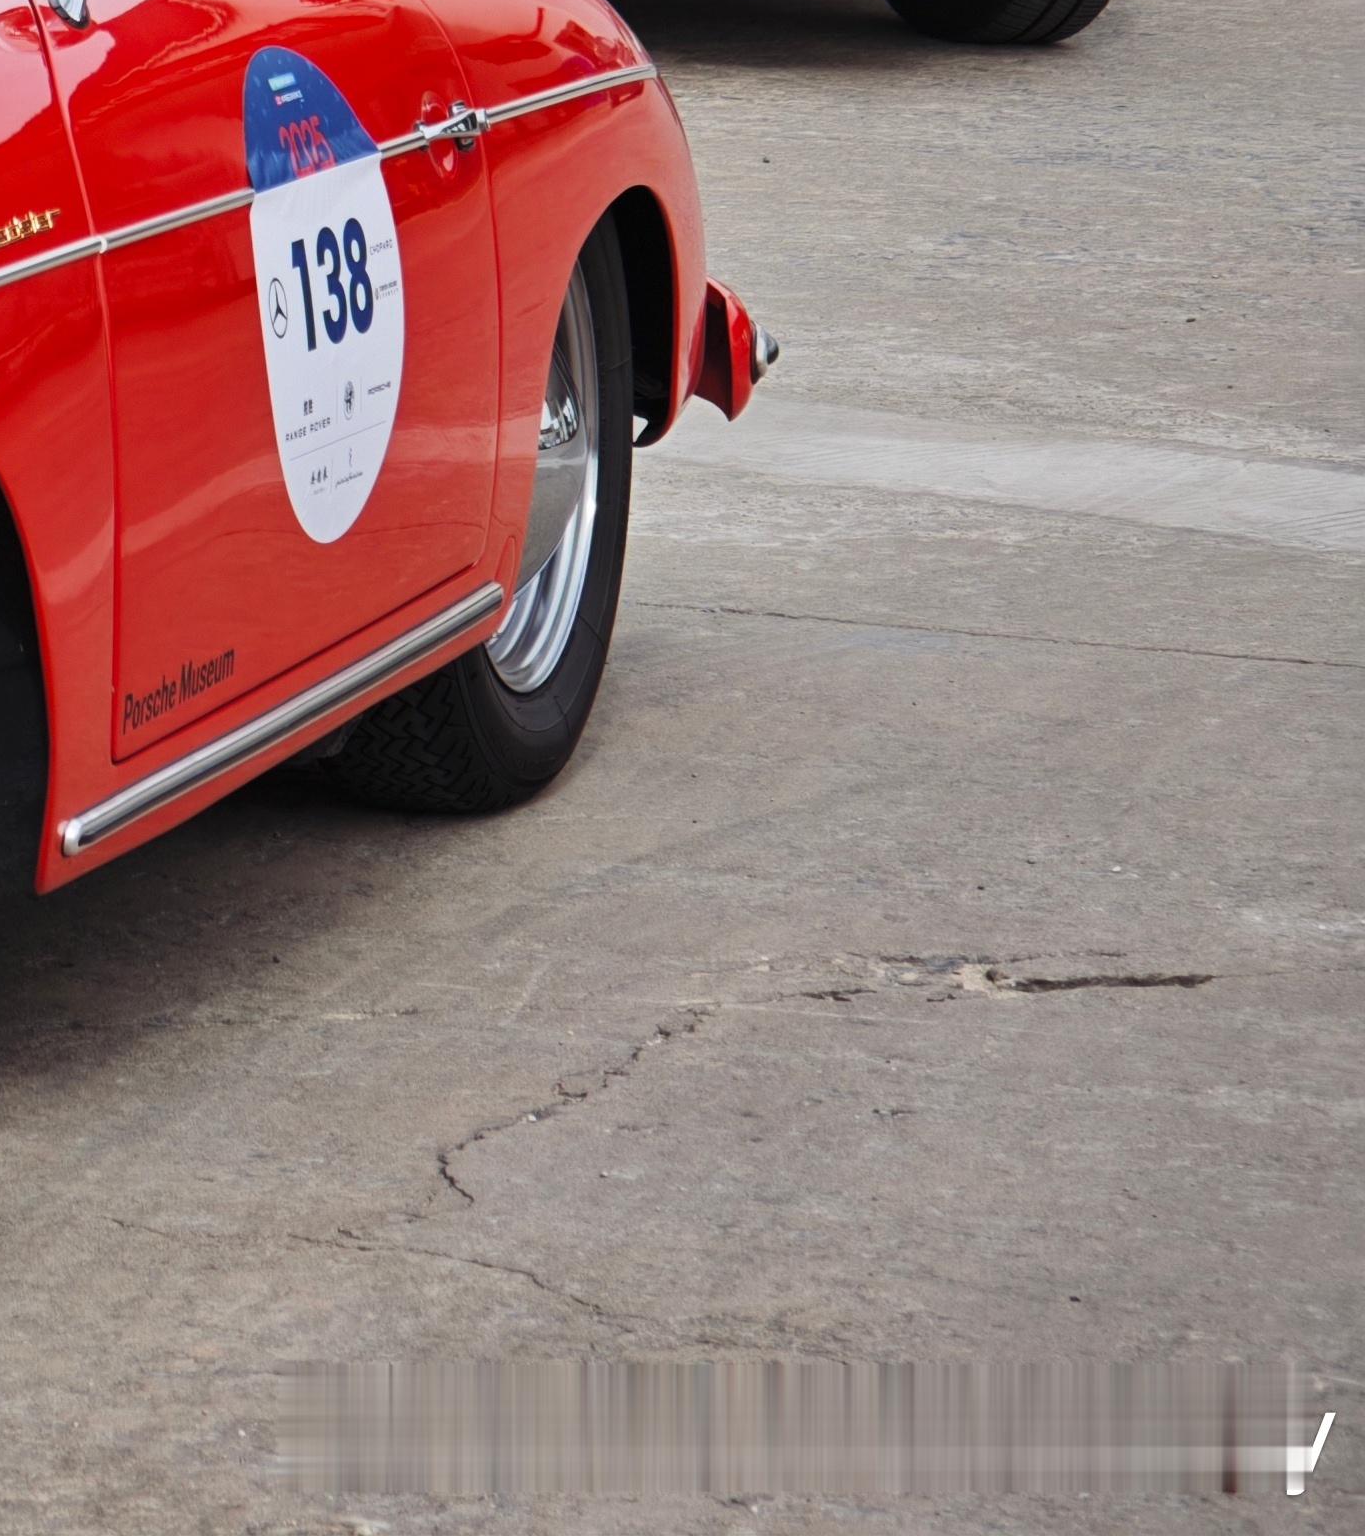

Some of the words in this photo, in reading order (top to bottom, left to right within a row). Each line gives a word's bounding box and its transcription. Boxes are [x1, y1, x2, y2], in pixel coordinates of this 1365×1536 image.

[291, 217, 374, 353] 138
[123, 675, 176, 736] Porsche
[178, 648, 235, 704] Museum
